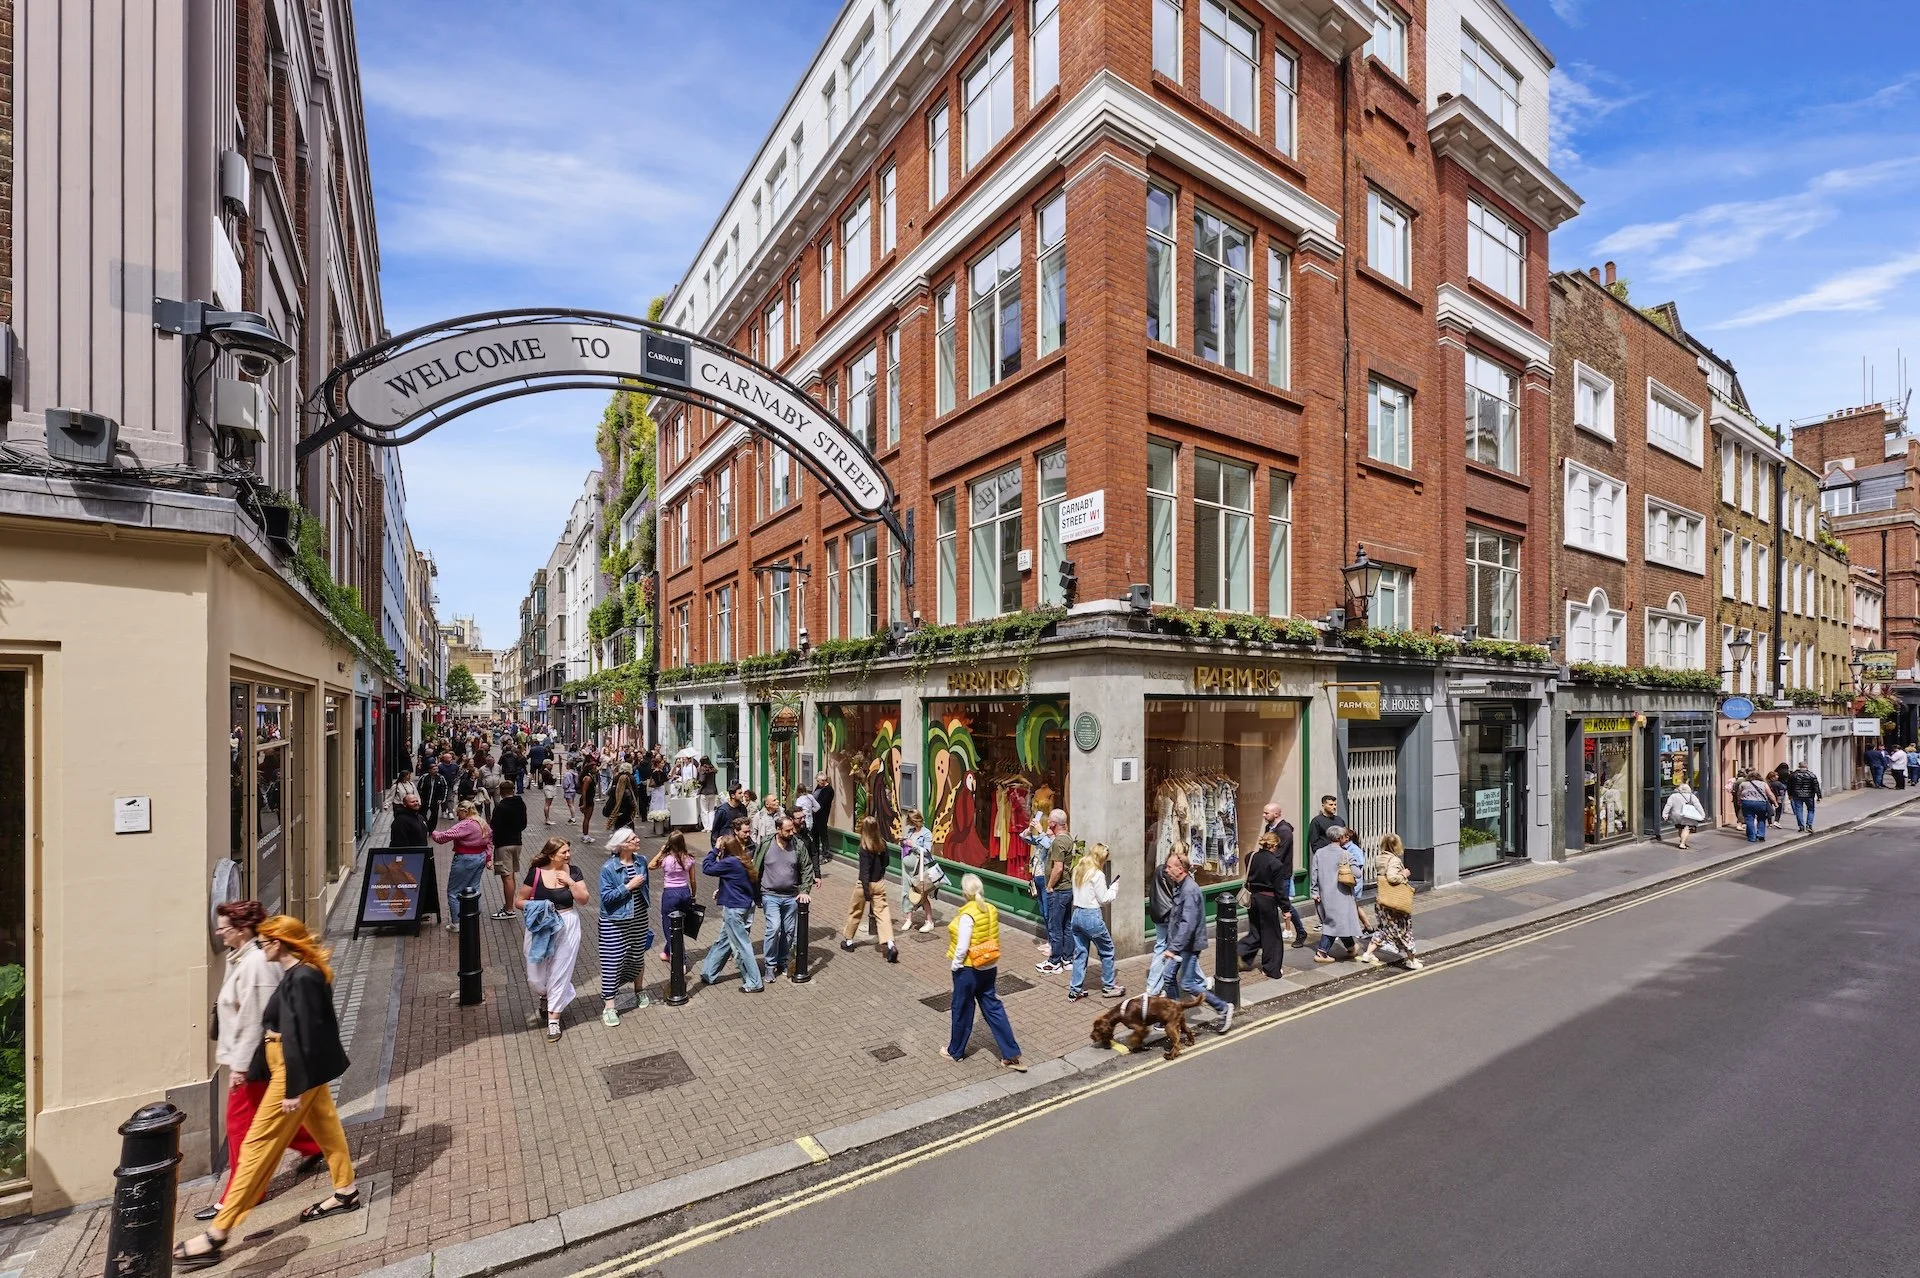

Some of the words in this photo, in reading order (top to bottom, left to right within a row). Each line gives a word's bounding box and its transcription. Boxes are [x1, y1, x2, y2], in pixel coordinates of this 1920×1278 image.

[384, 338, 546, 399] WELCOME
[572, 336, 610, 359] TO
[647, 350, 684, 366] CARNABY
[701, 363, 812, 433] CARNABY
[813, 431, 878, 499] STREET
[1061, 497, 1094, 517] CARNABY
[1061, 512, 1087, 529] STREET
[1089, 509, 1100, 520] W1
[946, 670, 992, 690] FARM
[1193, 666, 1252, 689] FARM
[1254, 668, 1281, 690] RIO
[1339, 701, 1362, 709] FARM
[1363, 701, 1377, 709] RIO
[1391, 699, 1420, 711] HOUSE
[1593, 719, 1619, 731] MOSCOT
